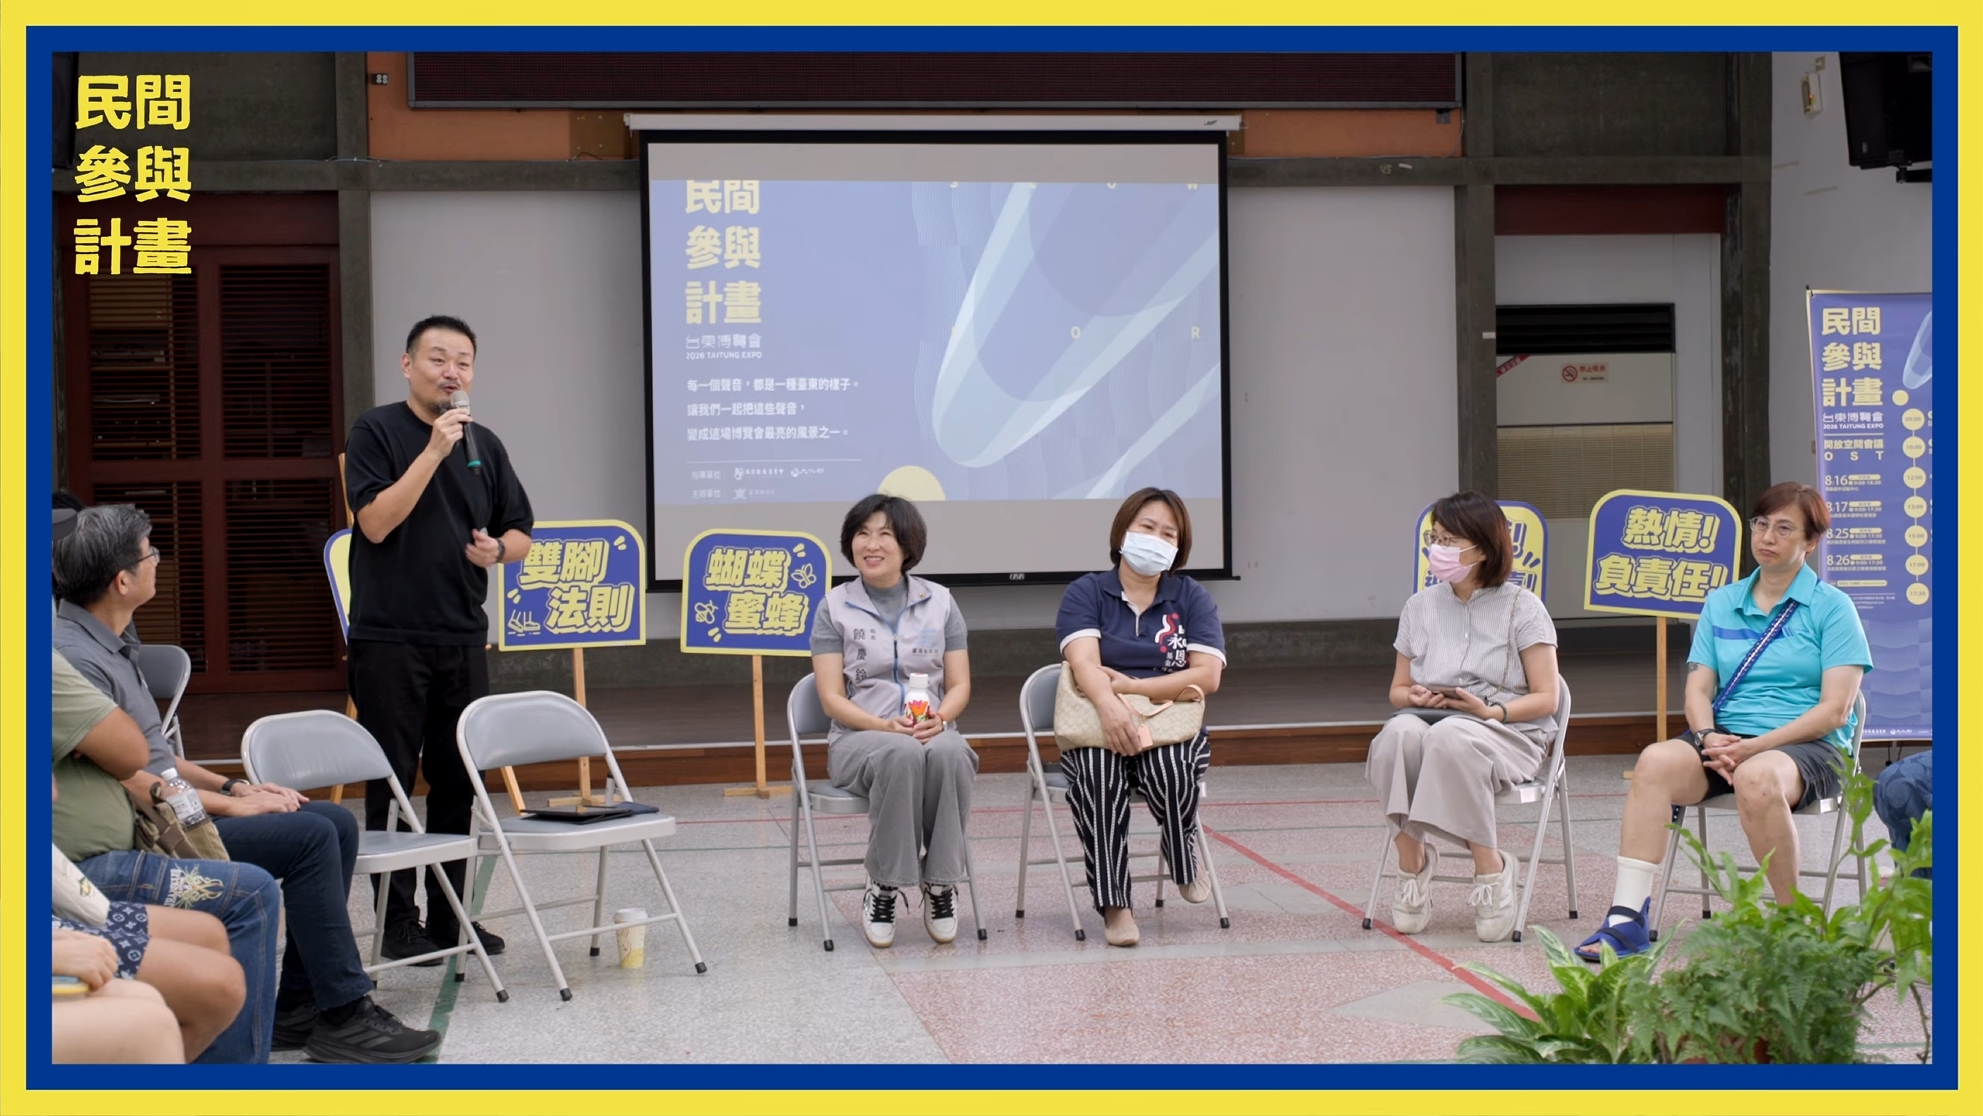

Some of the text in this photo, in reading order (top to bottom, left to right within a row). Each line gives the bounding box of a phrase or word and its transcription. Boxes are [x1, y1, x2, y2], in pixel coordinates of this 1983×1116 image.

[685, 180, 761, 215] 民間
[685, 225, 762, 270] 參與
[684, 280, 762, 325] 計畫
[1821, 306, 1881, 336] 民間
[685, 350, 763, 360] 2026 TAITUNG EXPO
[1821, 341, 1883, 372] 參與
[1821, 376, 1884, 408] 計畫
[1622, 505, 1721, 554] 熱情!
[517, 537, 609, 589] 雙腳
[703, 546, 790, 592] 蝴蝶
[1593, 553, 1729, 602] 負責任!
[543, 584, 635, 634] 法則
[724, 590, 809, 636] 蜜蜂
